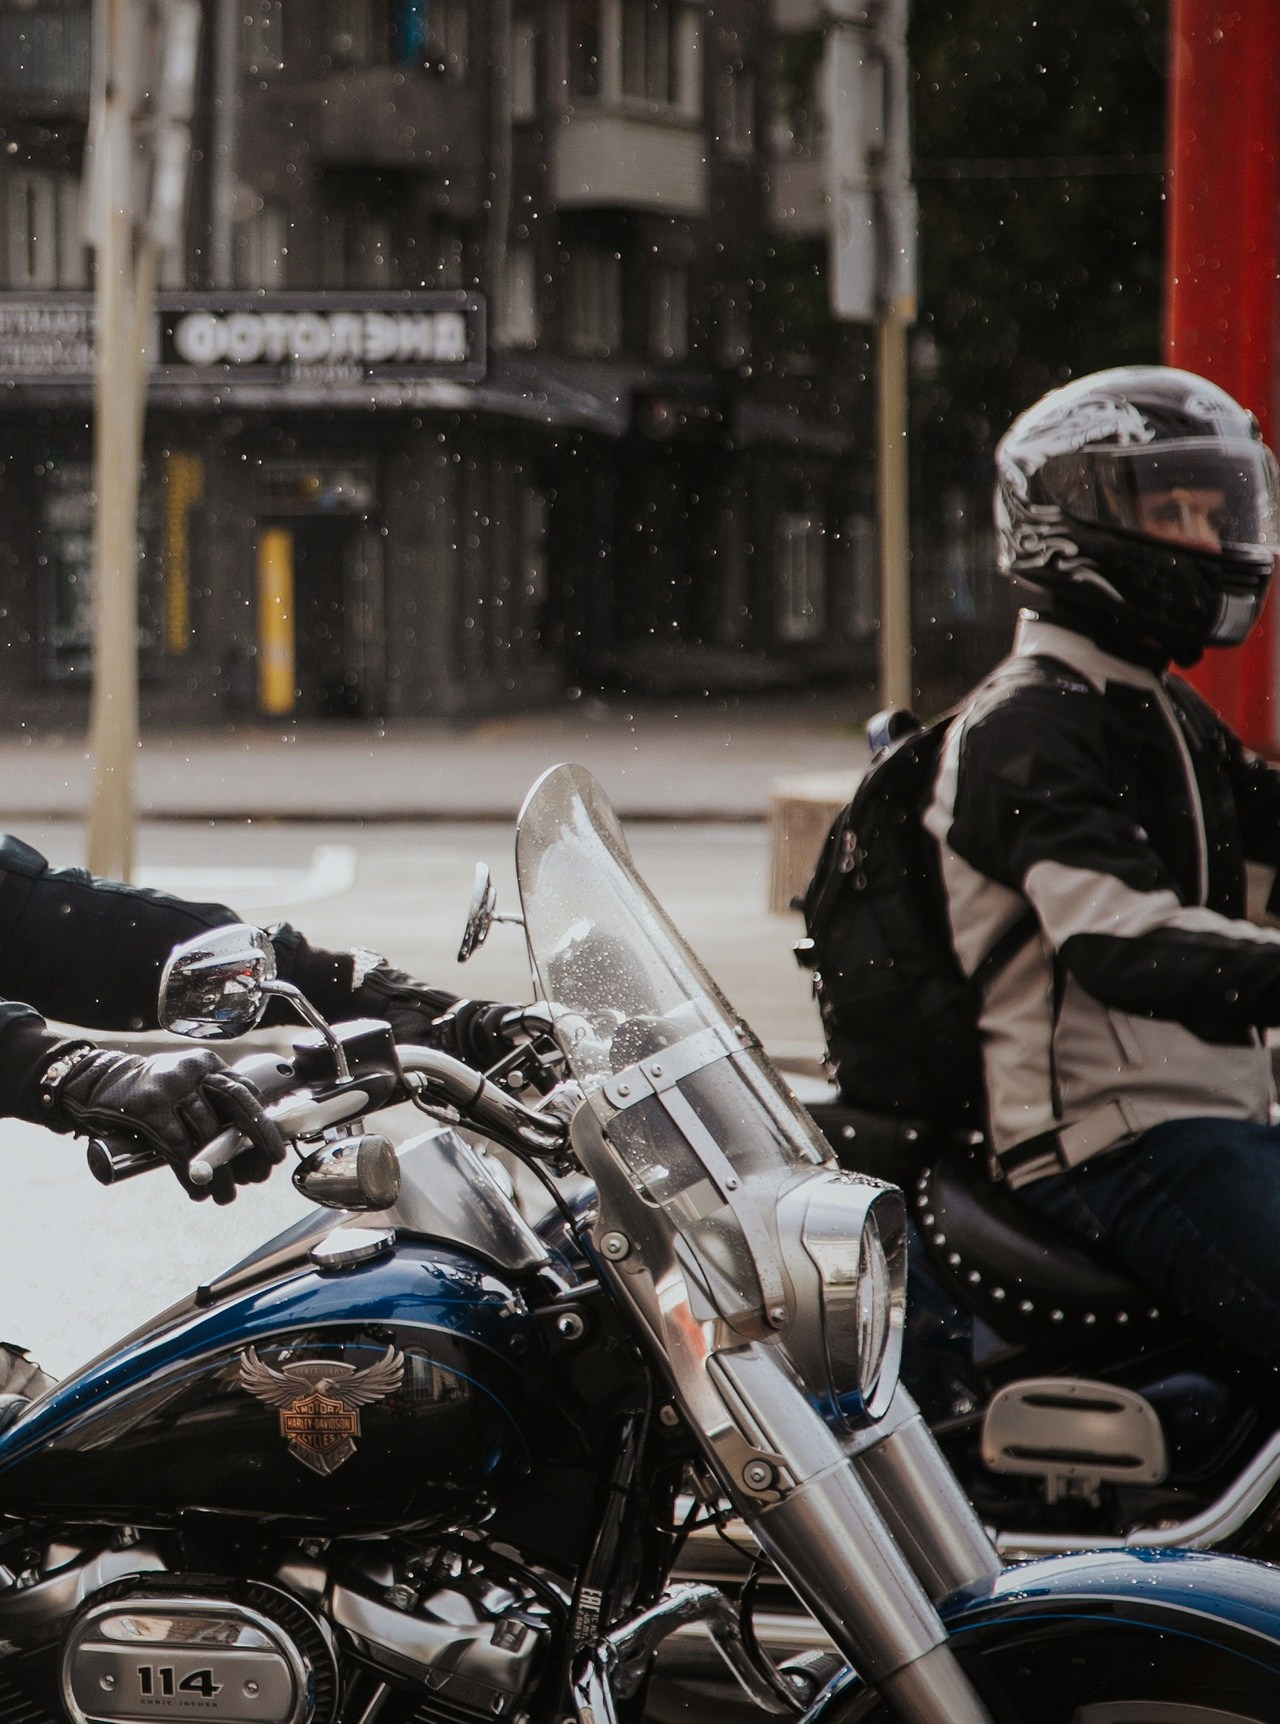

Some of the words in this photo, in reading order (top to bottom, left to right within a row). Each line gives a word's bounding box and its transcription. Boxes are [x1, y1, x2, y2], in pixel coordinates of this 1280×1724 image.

[300, 1403, 335, 1414] MOTOR
[302, 1433, 336, 1447] CYCLES
[137, 1665, 224, 1699] 114
